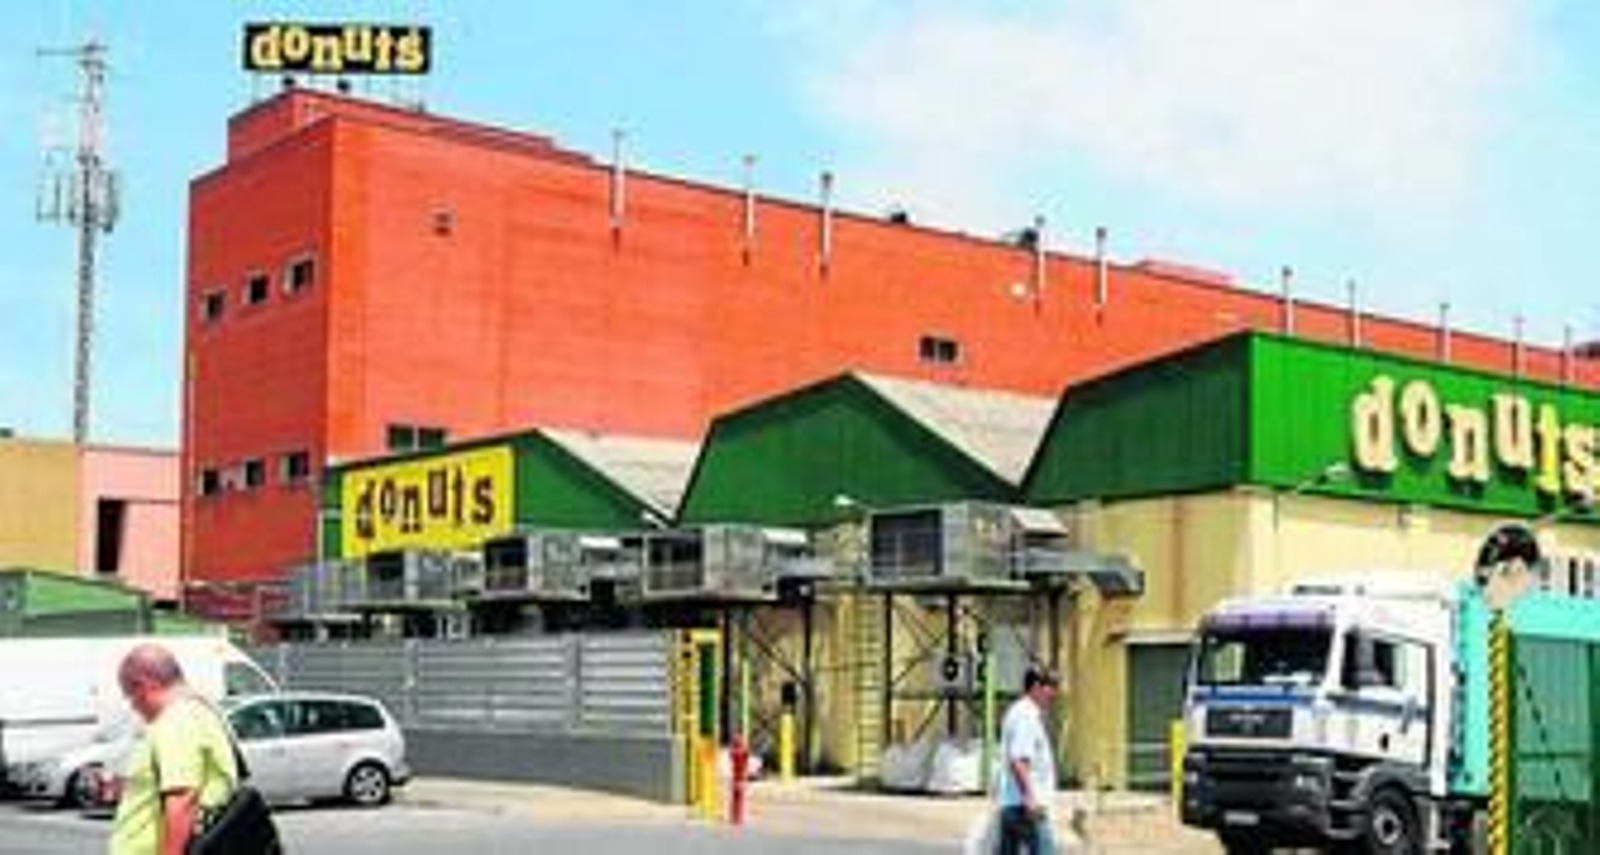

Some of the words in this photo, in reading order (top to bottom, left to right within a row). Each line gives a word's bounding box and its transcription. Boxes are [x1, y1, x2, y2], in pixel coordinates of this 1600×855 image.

[252, 25, 425, 70] donuts
[1353, 375, 1600, 502] donuts
[356, 465, 496, 539] donuts
